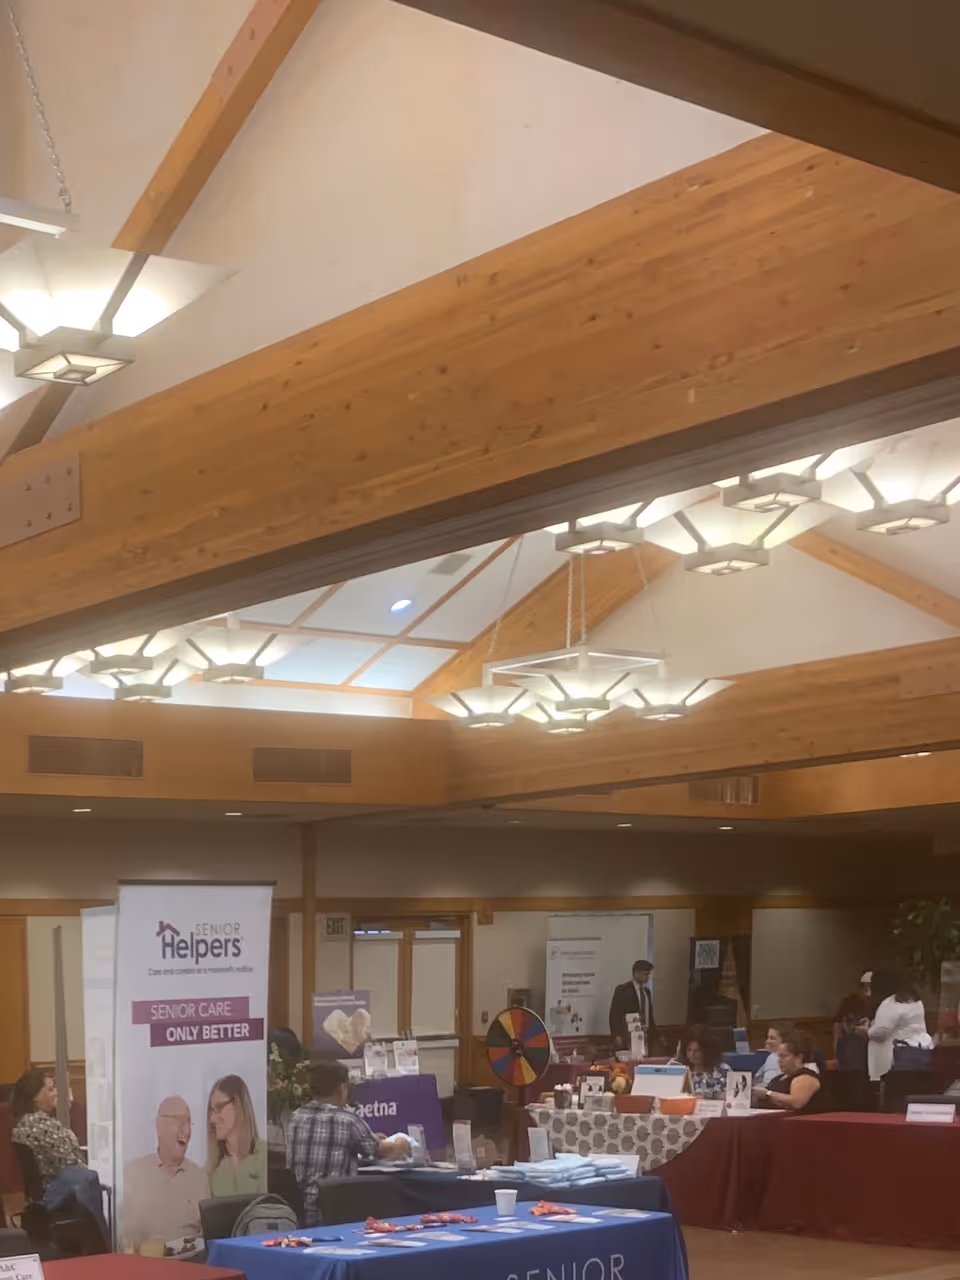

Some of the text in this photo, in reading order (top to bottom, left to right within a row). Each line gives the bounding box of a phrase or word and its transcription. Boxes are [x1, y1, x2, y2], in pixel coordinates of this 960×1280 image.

[195, 922, 241, 936] SENIOR
[326, 917, 345, 935] EXIT
[162, 931, 242, 965] Helpers
[151, 1001, 232, 1020] SENIOR CARE
[166, 1023, 250, 1042] ONLY BETTER
[356, 1100, 397, 1117] aetna
